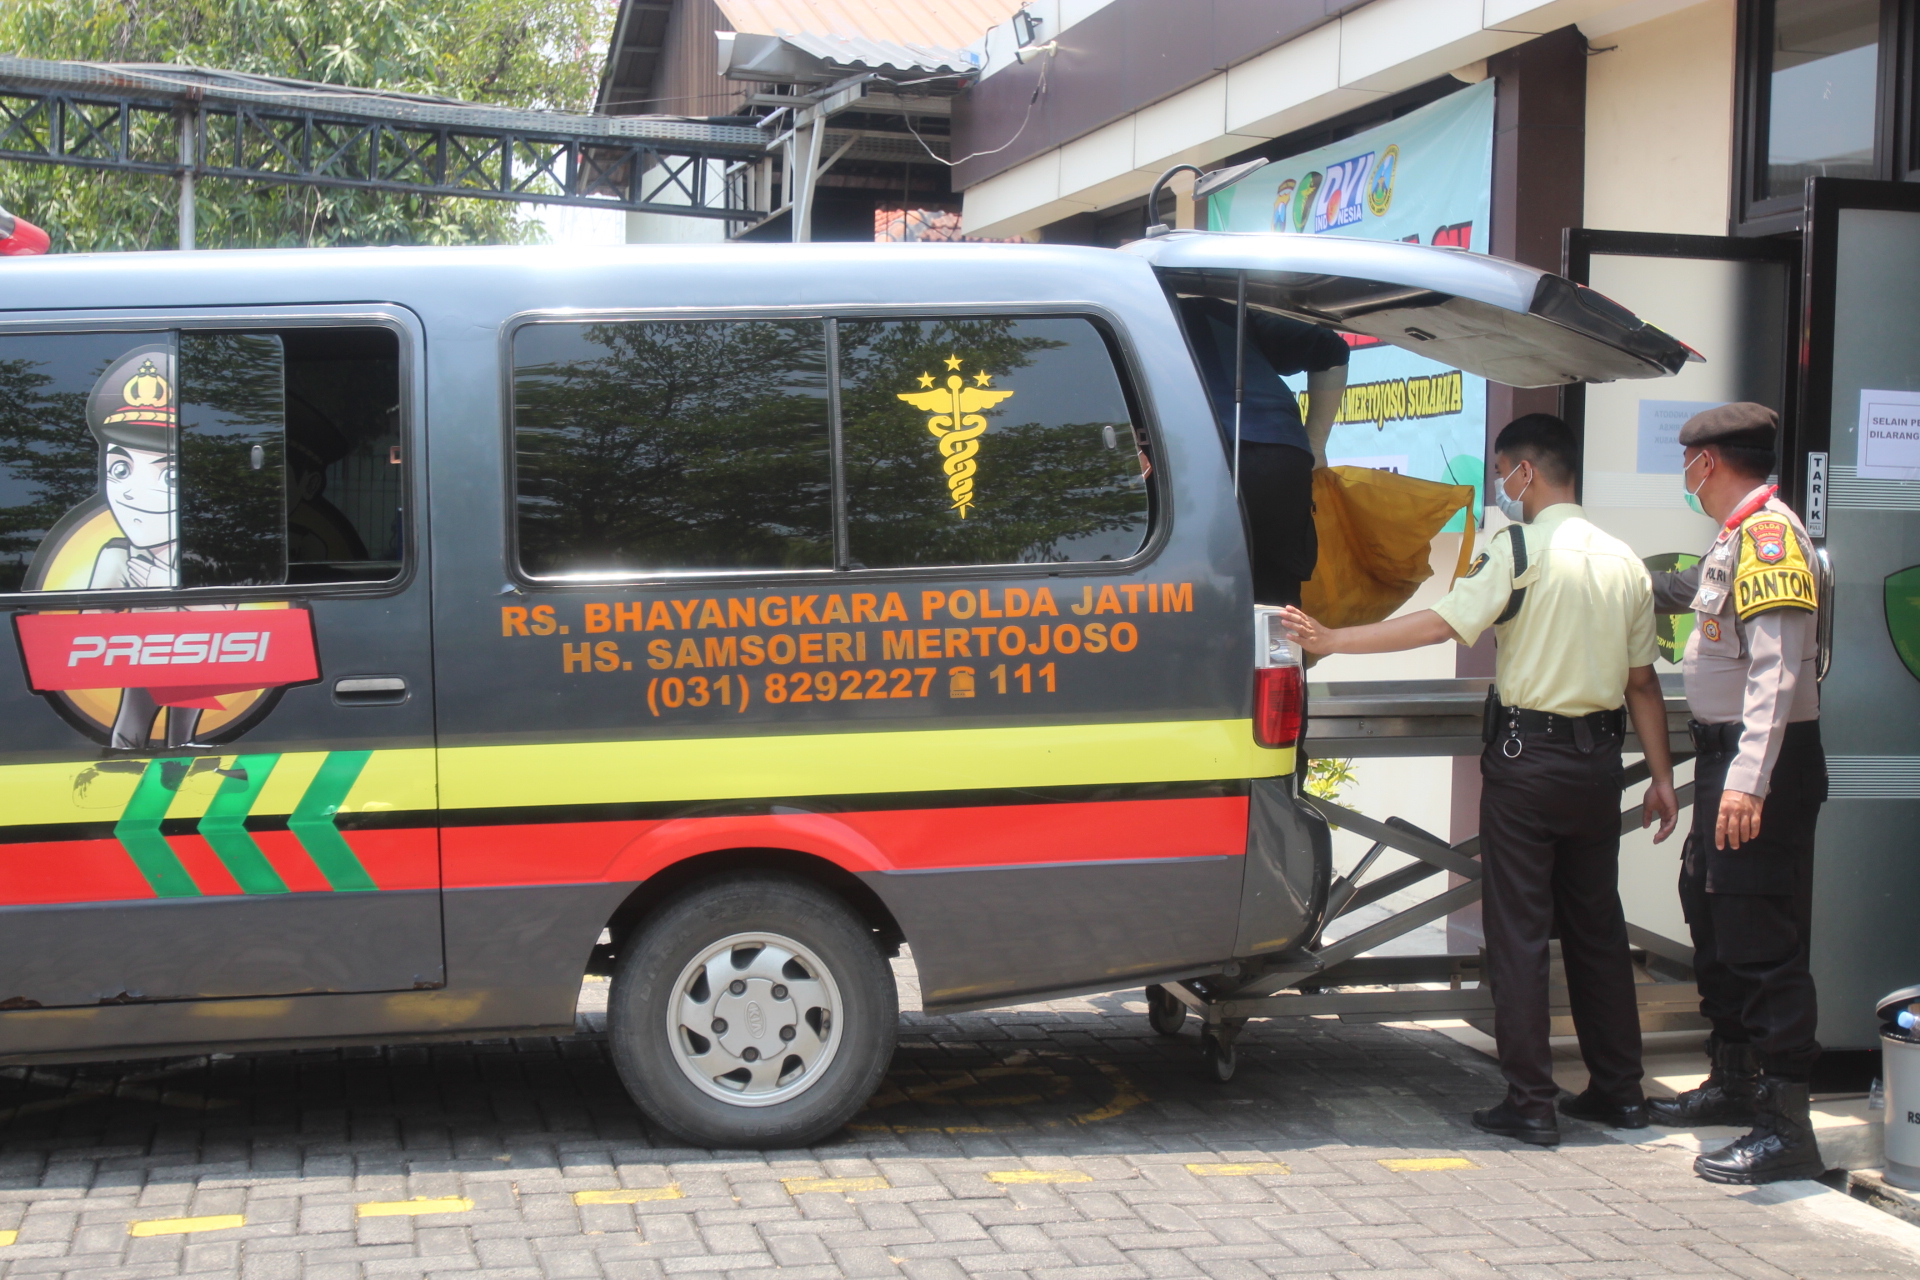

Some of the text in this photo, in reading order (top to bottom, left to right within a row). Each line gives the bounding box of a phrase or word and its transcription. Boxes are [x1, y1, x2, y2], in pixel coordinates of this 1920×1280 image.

[1316, 153, 1375, 216] DVI
[1345, 378, 1407, 431] MERTOJOSO
[1407, 370, 1463, 420] SURABAYA
[1872, 417, 1908, 427] SELAIN
[1869, 431, 1920, 441] DILARANG
[1811, 458, 1823, 520] TARIK
[1753, 523, 1780, 532] POLDA
[1706, 567, 1727, 583] POLRI
[1740, 571, 1813, 607] DANTON
[502, 583, 1193, 637] RS. BHAYANGKARA POLDA JATIM
[67, 631, 271, 667] PRESISI
[563, 622, 1138, 673] HS. SAMSOERI MERTOJOSO
[647, 662, 1056, 717] (031) 8292227 111
